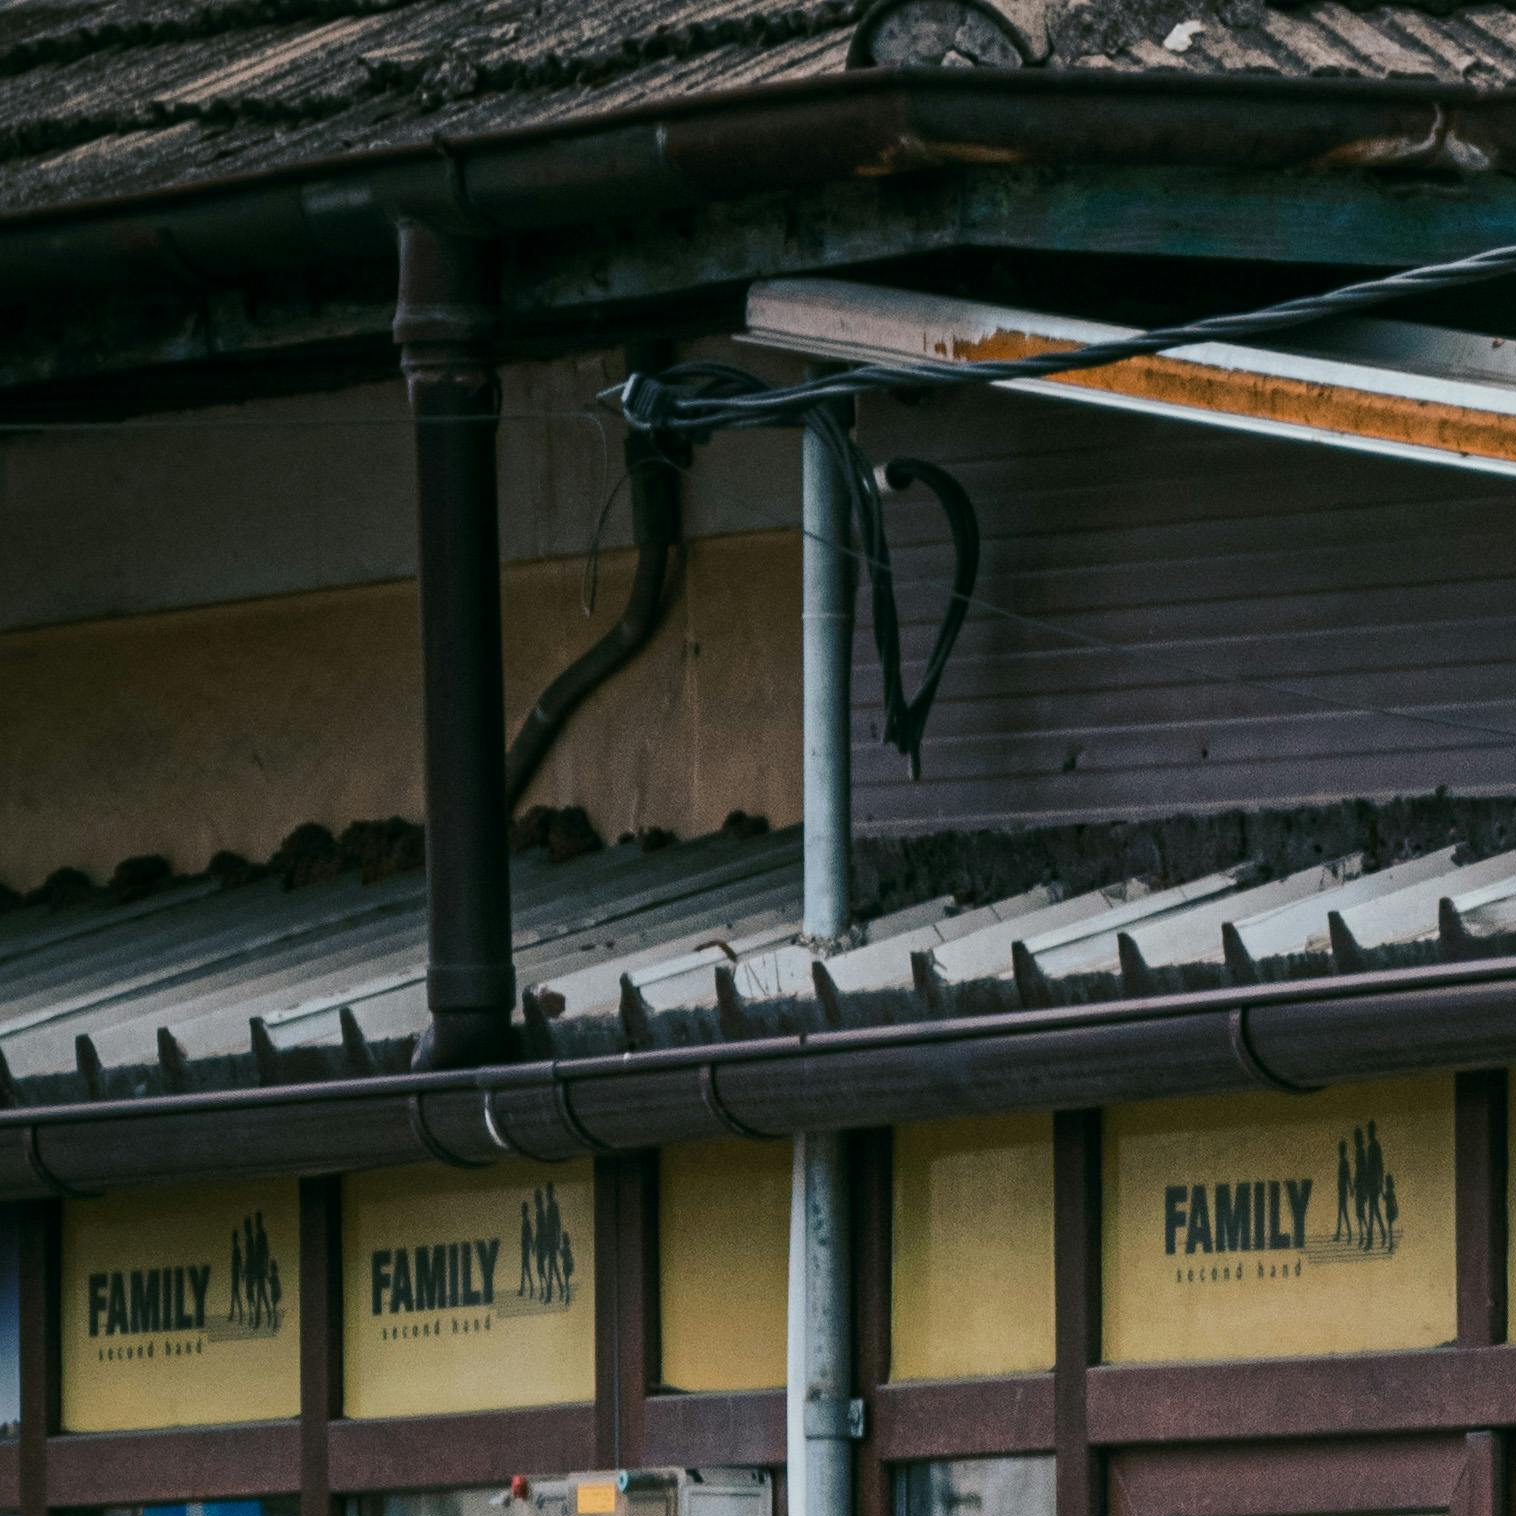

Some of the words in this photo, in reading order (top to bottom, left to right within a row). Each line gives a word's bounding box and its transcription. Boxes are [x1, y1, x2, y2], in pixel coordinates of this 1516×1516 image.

[1164, 1178, 1313, 1255] FAMILY
[88, 1264, 211, 1338] FAMILY
[371, 1236, 501, 1317] FAMILY
[1175, 1262, 1244, 1284] second
[1256, 1258, 1304, 1279] hand
